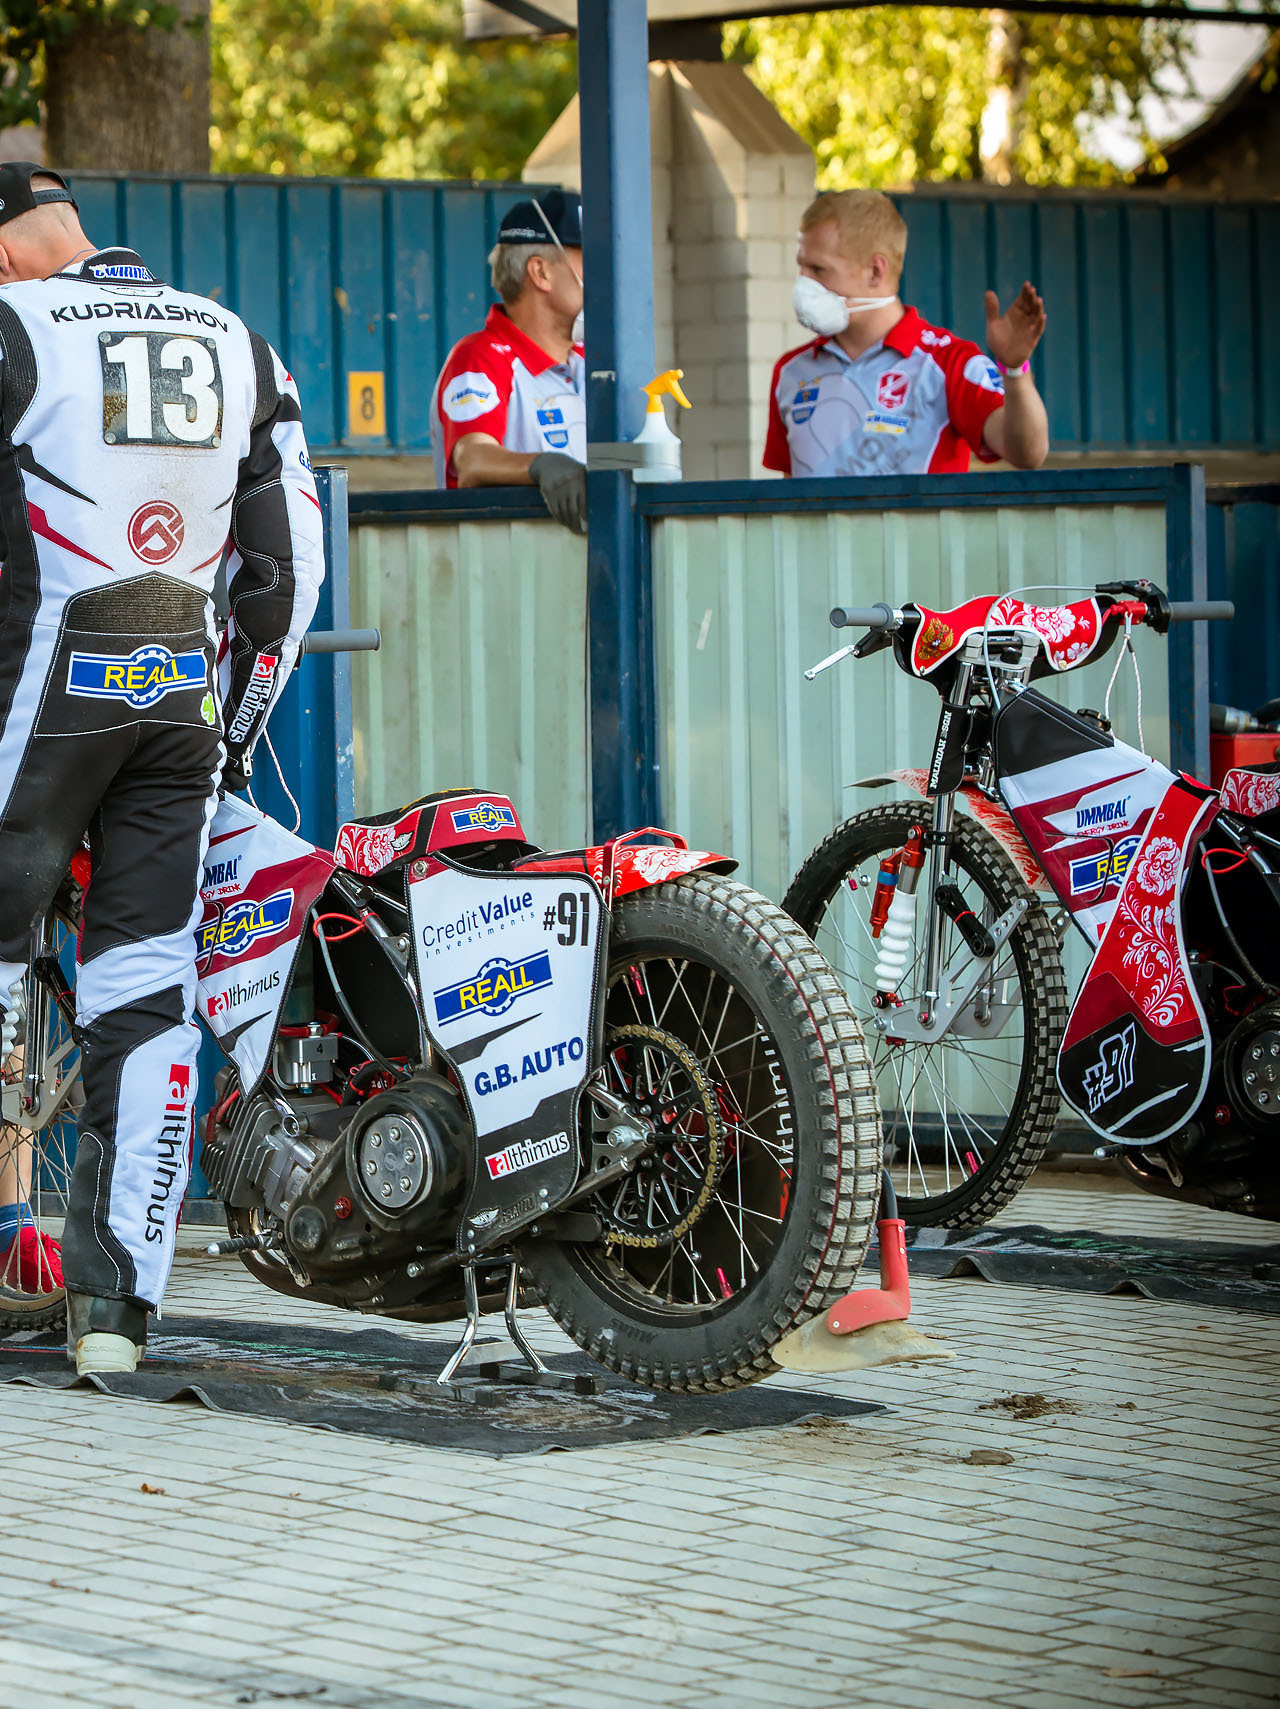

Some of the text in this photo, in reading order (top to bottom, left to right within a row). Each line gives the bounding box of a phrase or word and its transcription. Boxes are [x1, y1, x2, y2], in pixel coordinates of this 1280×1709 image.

[50, 302, 228, 333] KUDRIASHOV
[106, 336, 219, 442] 13
[361, 385, 374, 421] 8
[103, 658, 187, 690] REALL
[230, 654, 275, 743] althimus
[469, 810, 508, 824] REALL
[1076, 798, 1128, 828] UMMBA!
[217, 883, 241, 896] DRINK
[203, 906, 274, 948] REALL
[426, 911, 535, 959] Investments
[543, 892, 591, 947] #91
[207, 970, 280, 1018] althimus
[459, 966, 534, 1010] REALL
[316, 1043, 324, 1055] 4
[474, 1036, 584, 1097] G.B. AUTO
[1082, 1022, 1137, 1114] #91
[145, 1064, 190, 1244] althimus
[487, 1133, 568, 1177] althimus
